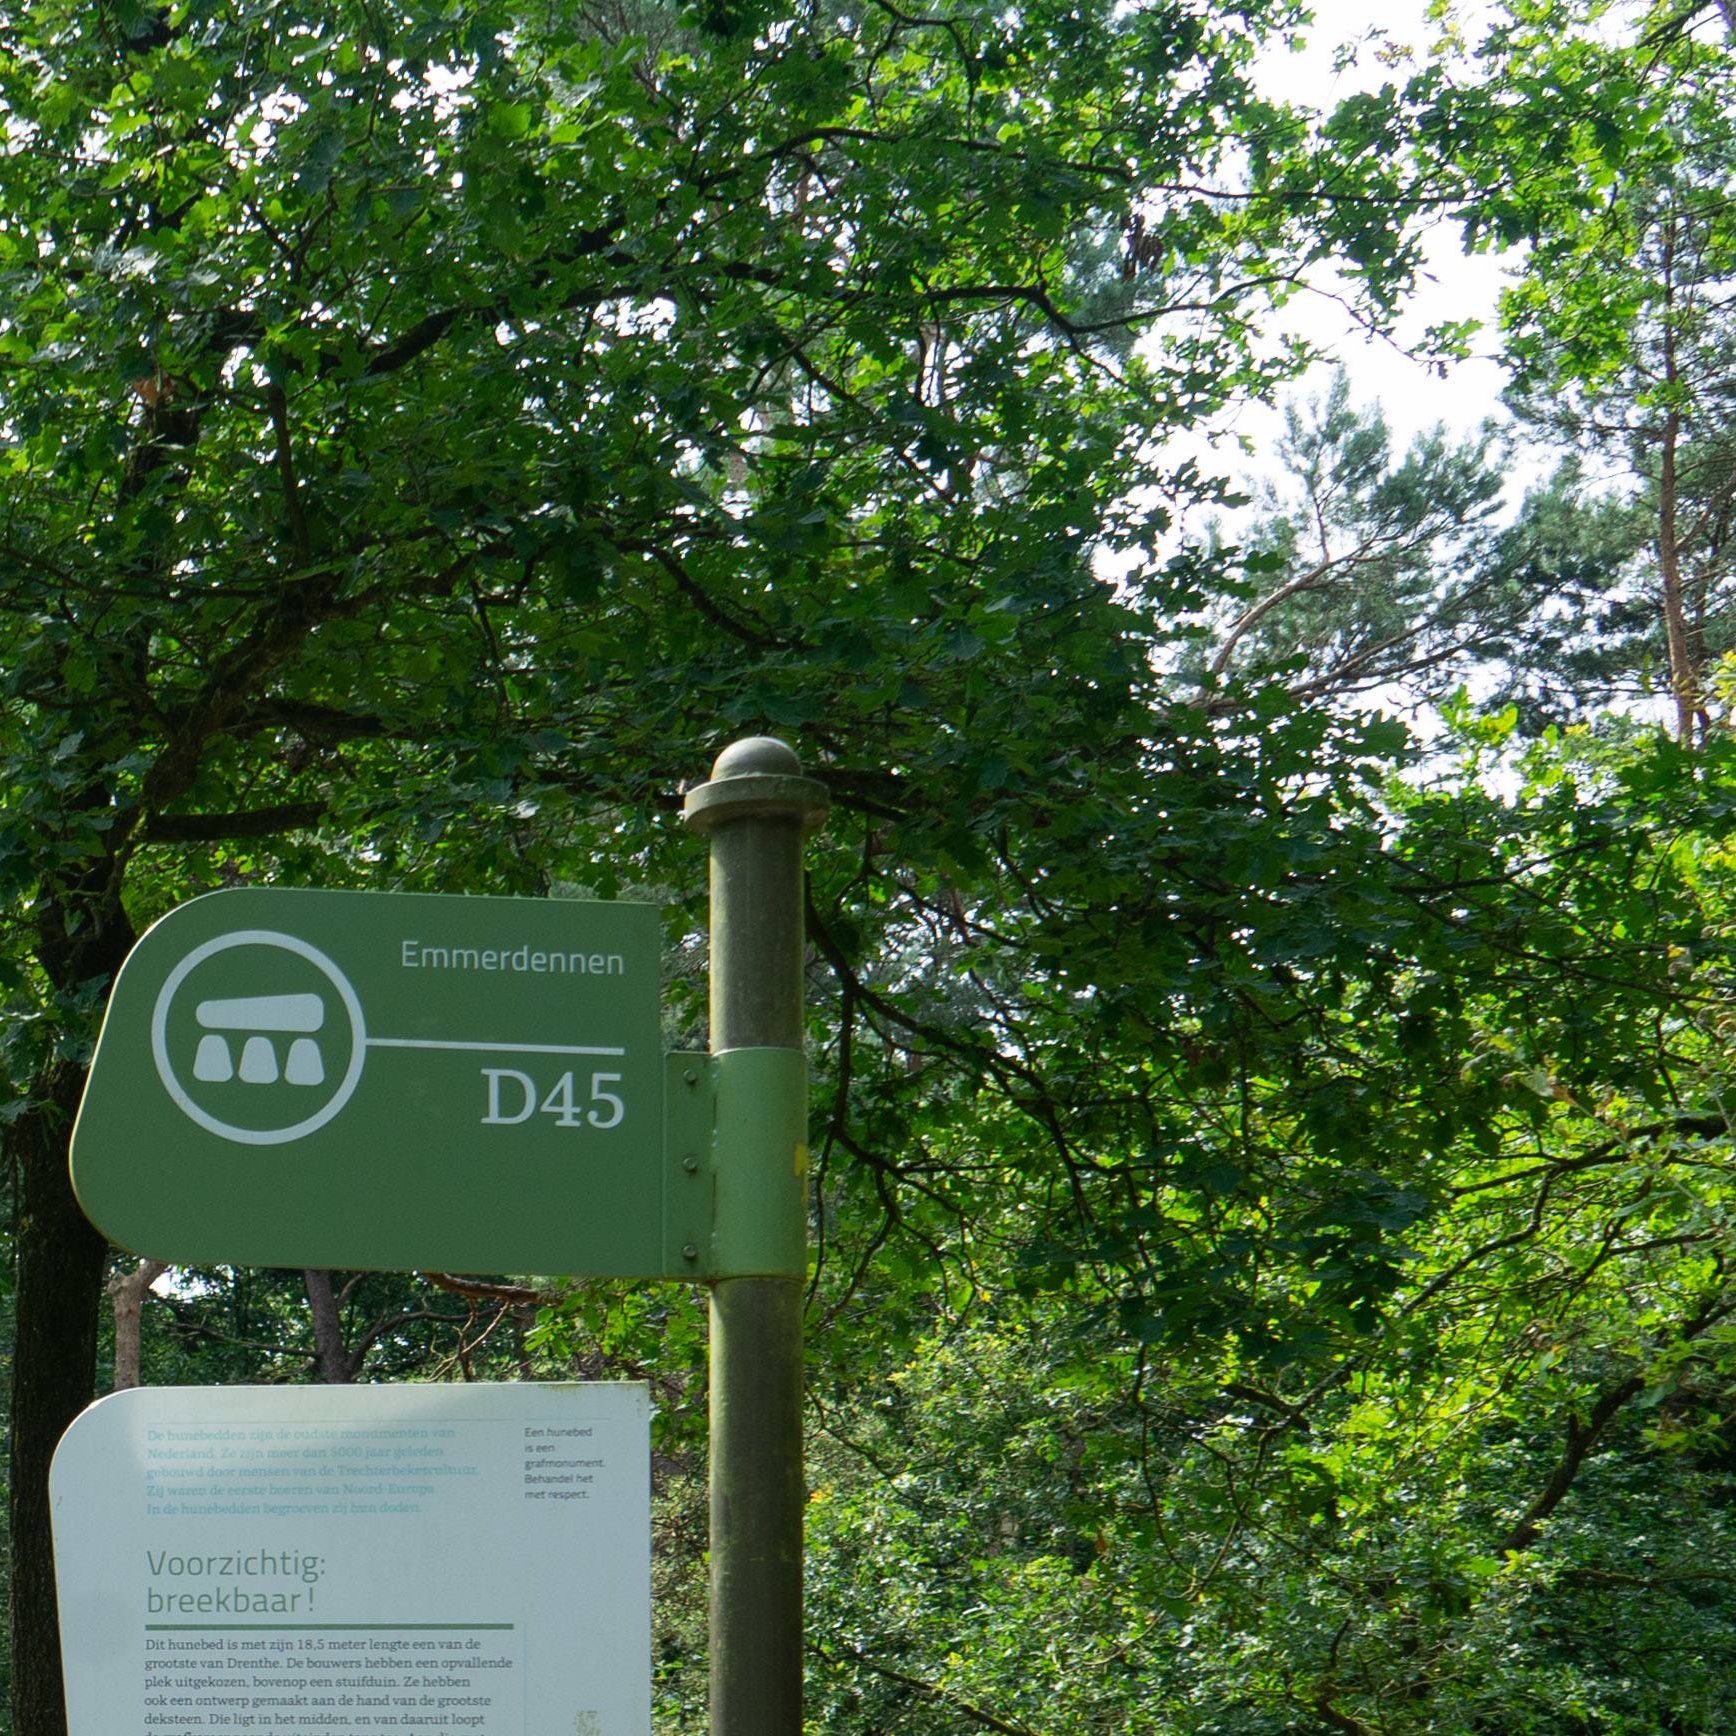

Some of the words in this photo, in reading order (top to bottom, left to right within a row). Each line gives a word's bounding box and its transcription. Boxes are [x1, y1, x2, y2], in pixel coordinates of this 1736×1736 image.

[400, 940, 624, 976] Emmerdennen
[480, 1068, 625, 1129] D45
[524, 1427, 544, 1437] Een
[546, 1427, 593, 1437] hunebed
[524, 1443, 533, 1453] is
[524, 1474, 574, 1483] Behandel
[575, 1473, 593, 1483] het
[525, 1490, 546, 1499] met
[146, 1549, 326, 1583] Voorzichtig:
[145, 1637, 165, 1650] Dit
[167, 1637, 224, 1650] hunebed
[226, 1637, 238, 1649] is
[240, 1638, 266, 1649] met
[268, 1637, 294, 1653] zijn
[297, 1637, 324, 1651] 18,5
[327, 1638, 366, 1649] meter
[368, 1637, 410, 1653] lengte
[411, 1640, 436, 1649] een
[437, 1640, 462, 1649] van
[464, 1637, 481, 1649] de
[144, 1657, 197, 1672] grootste
[199, 1659, 223, 1668] van
[226, 1656, 282, 1668] Drenthe.
[285, 1656, 304, 1668] De
[305, 1656, 362, 1668] bouwers
[364, 1656, 413, 1668] hebben
[414, 1659, 438, 1668] een
[440, 1656, 512, 1672] opvallende
[144, 1674, 172, 1690] plek
[174, 1674, 249, 1690] uitgekozen,
[252, 1674, 307, 1690] bovenop
[308, 1678, 332, 1687] een
[334, 1674, 399, 1687] stuifduin.
[402, 1674, 420, 1687] Ze
[421, 1674, 470, 1687] hebben
[143, 1693, 168, 1705] ook
[169, 1697, 193, 1705] een
[194, 1694, 250, 1709] ontwerp
[251, 1693, 308, 1709] gemaakt
[310, 1697, 336, 1705] aan
[337, 1693, 354, 1705] de
[355, 1693, 390, 1705] hand
[392, 1697, 417, 1705] van
[418, 1693, 435, 1705] de
[437, 1694, 492, 1709] grootste
[143, 1712, 205, 1724] deksteen.
[208, 1712, 231, 1724] Die
[233, 1712, 255, 1728] ligt
[258, 1712, 272, 1724] in
[274, 1712, 295, 1724] het
[297, 1712, 351, 1726] midden,
[354, 1716, 371, 1724] en
[373, 1716, 398, 1724] van
[399, 1712, 449, 1724] daaruit
[451, 1712, 485, 1728] loopt
